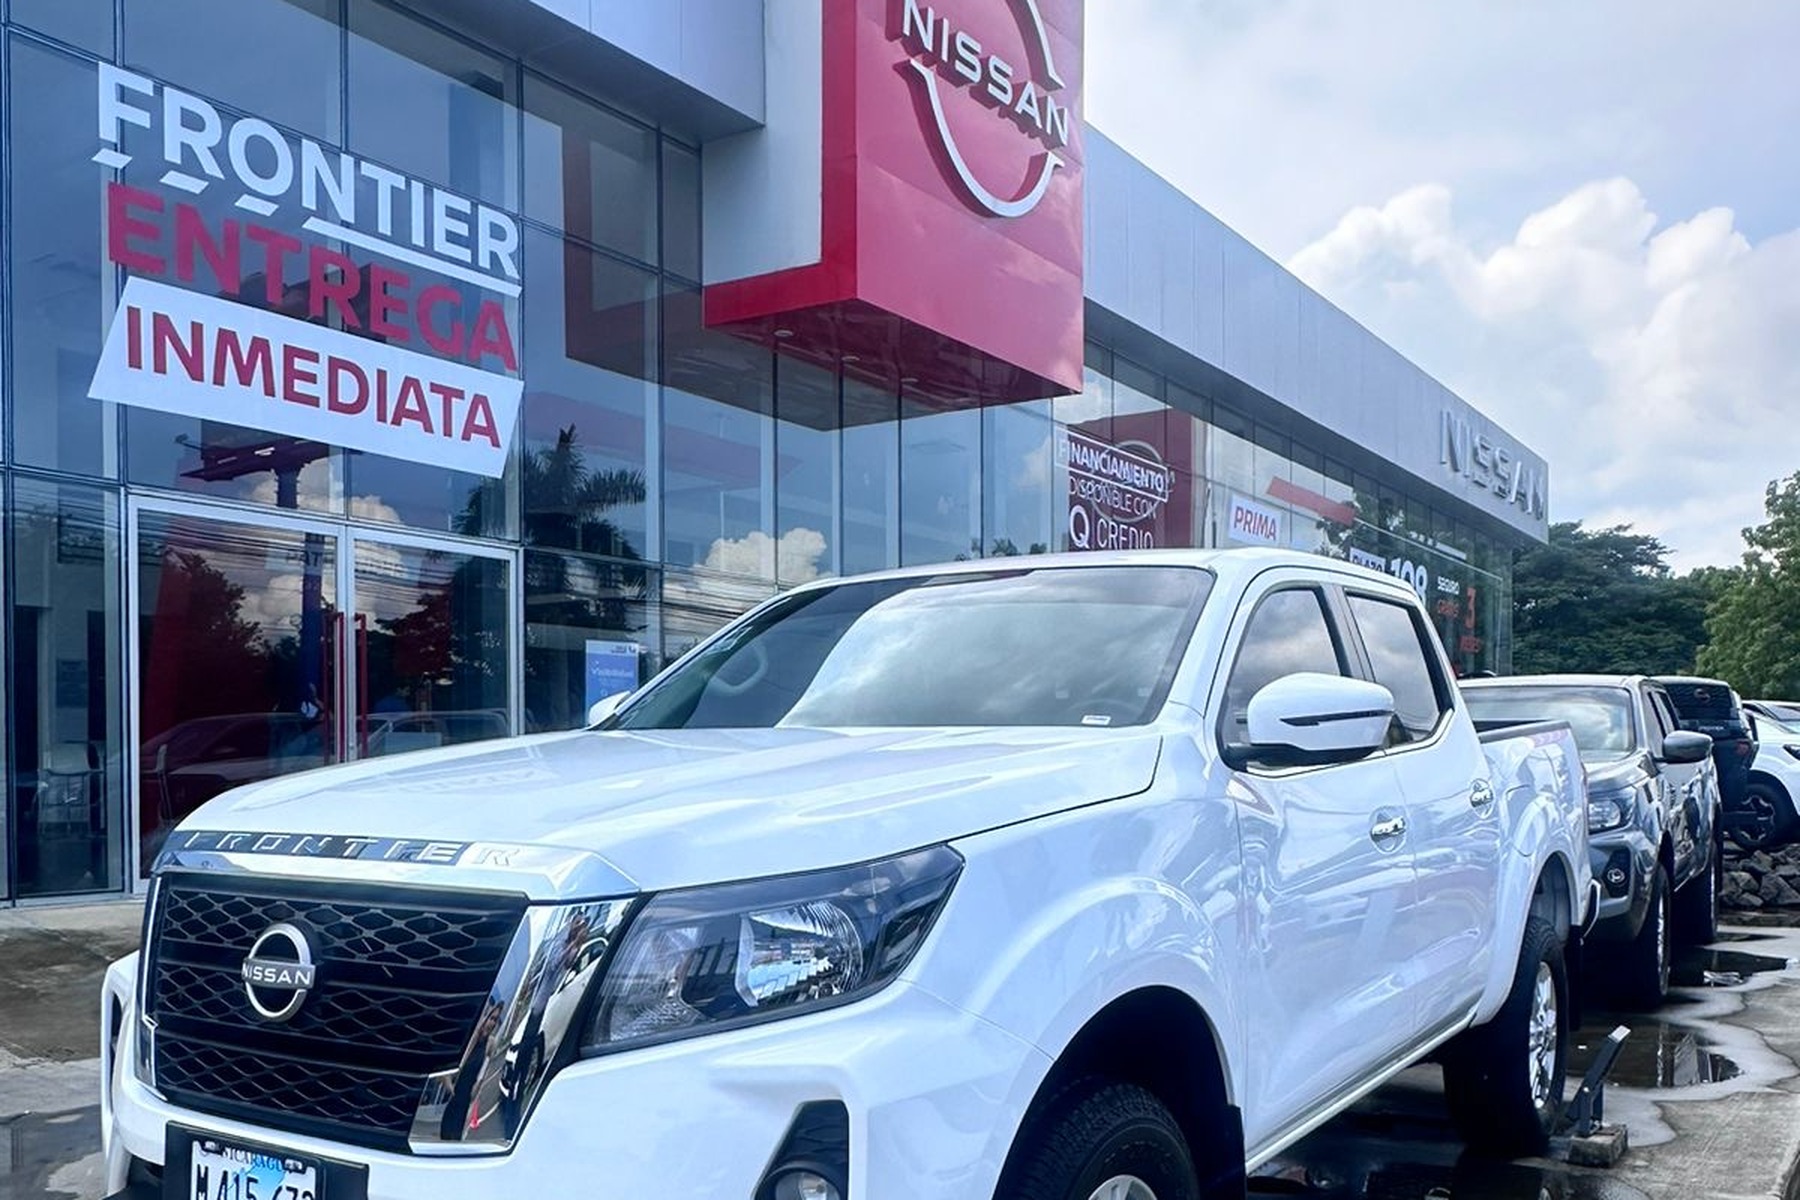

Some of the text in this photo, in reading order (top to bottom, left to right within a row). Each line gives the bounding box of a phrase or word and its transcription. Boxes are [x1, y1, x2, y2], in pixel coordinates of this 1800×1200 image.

[903, 0, 1068, 146] NISSAN
[99, 60, 520, 280] FRONTIER
[107, 181, 517, 371] ENTREGA
[126, 305, 501, 448] INMEDIATA
[1440, 408, 1544, 520] NISSAN
[1070, 505, 1090, 549] Q
[1233, 505, 1277, 541] PRIMA
[184, 831, 519, 867] FRONTIER
[242, 962, 311, 985] NISSAN
